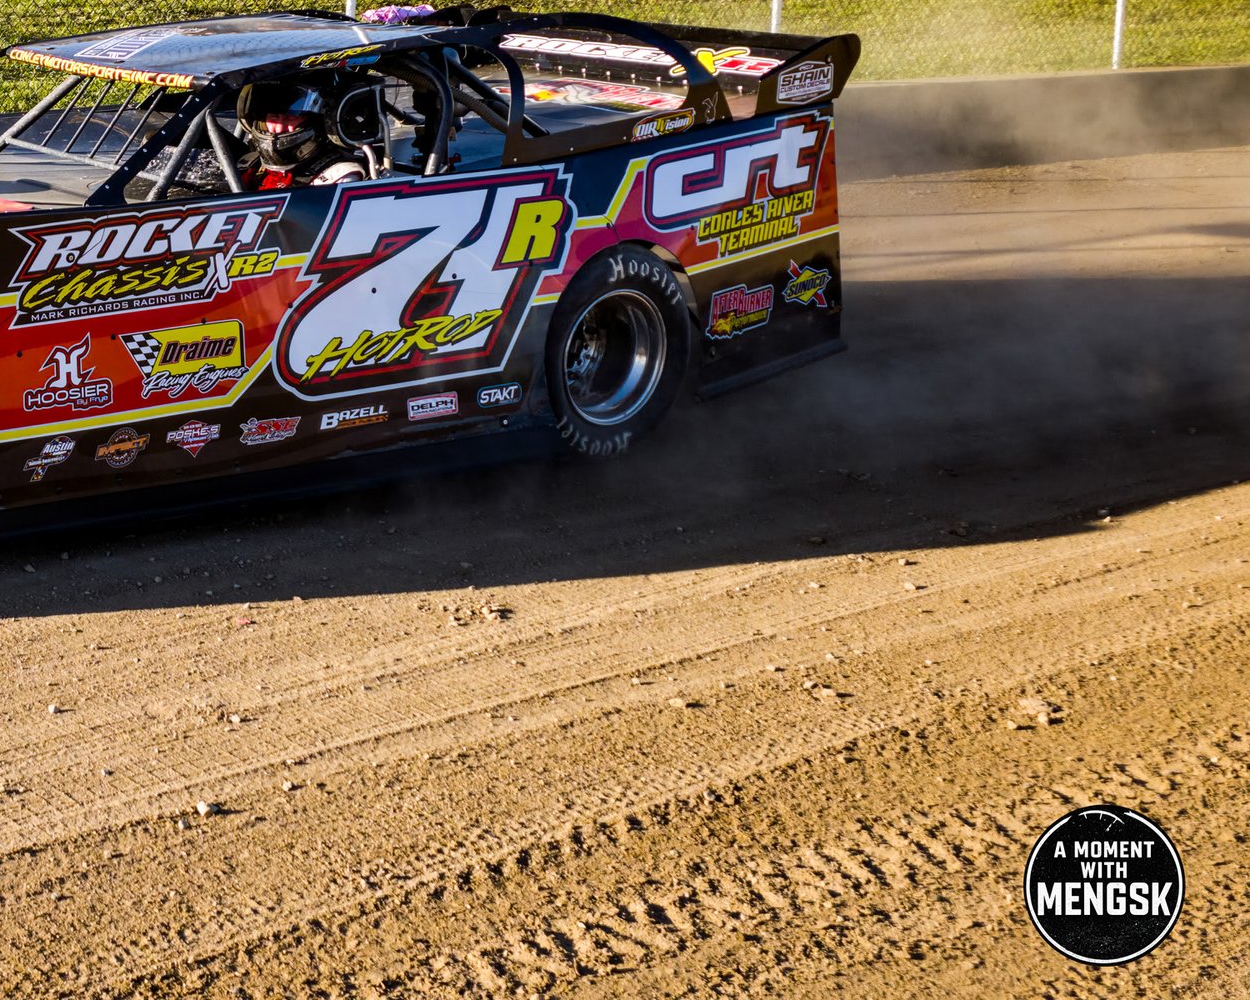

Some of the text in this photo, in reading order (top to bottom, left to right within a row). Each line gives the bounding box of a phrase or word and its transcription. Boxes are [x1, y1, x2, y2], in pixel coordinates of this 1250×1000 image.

[505, 34, 678, 64] ROCKE
[782, 68, 830, 87] SHAIN
[699, 190, 814, 238] CONLEY RIVER
[27, 204, 277, 274] ROCKET
[720, 216, 798, 253] TERMINAL
[22, 255, 208, 309] Chassis
[788, 275, 828, 297] SUNOCO
[31, 291, 204, 322] MARK RICHARDS RACING INC.
[159, 335, 237, 366] Draime
[27, 384, 109, 405] HOOSIER
[144, 363, 246, 397] Racing Engines
[320, 405, 388, 430] BAZELL
[411, 398, 454, 412] DELPH
[43, 440, 74, 454] Austin
